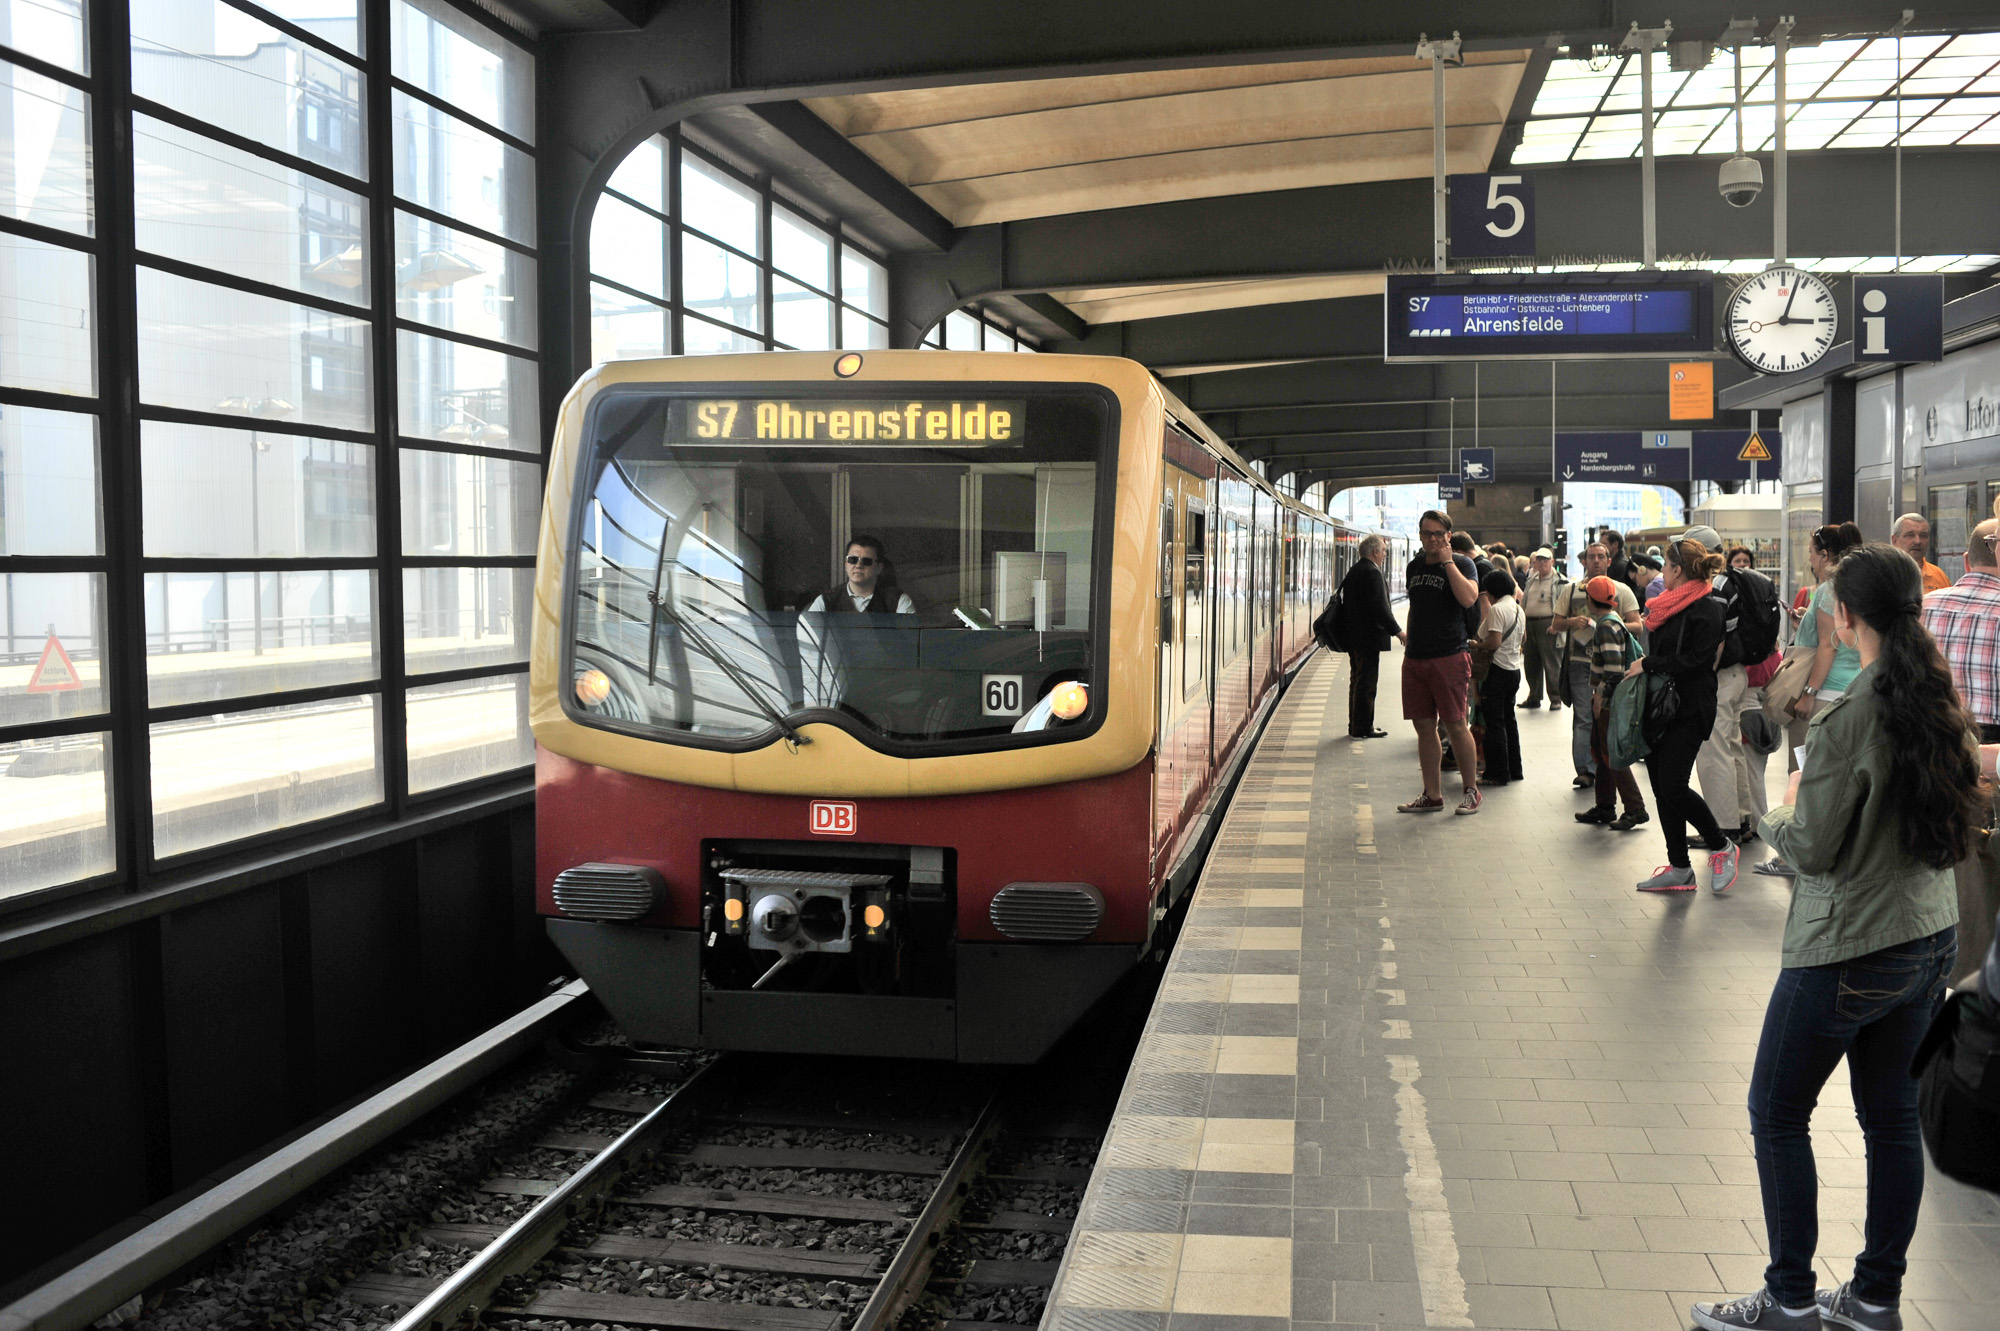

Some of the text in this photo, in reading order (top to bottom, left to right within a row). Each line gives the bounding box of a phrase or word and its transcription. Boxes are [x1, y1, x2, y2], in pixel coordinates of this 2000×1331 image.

[1485, 175, 1525, 238] 5
[1409, 297, 1430, 312] S7
[1463, 295, 1486, 304] Berlin
[1487, 295, 1501, 304] Hbf
[1509, 294, 1571, 303] Friedrichstraße
[1579, 293, 1643, 303] Alexanderplatz
[1463, 305, 1509, 314] Ostbahnhof
[1517, 304, 1555, 313] Ostkreuz
[1562, 303, 1611, 314] Lichtenberg
[1463, 315, 1564, 333] Ahrensfelde
[697, 402, 1012, 440] S7 Ahrensfelde
[1966, 396, 2000, 432] Infor
[1581, 451, 1608, 459] Ausgang
[1581, 463, 1635, 472] Hardenbergstraße
[986, 680, 1019, 711] 60
[817, 806, 850, 828] DB
